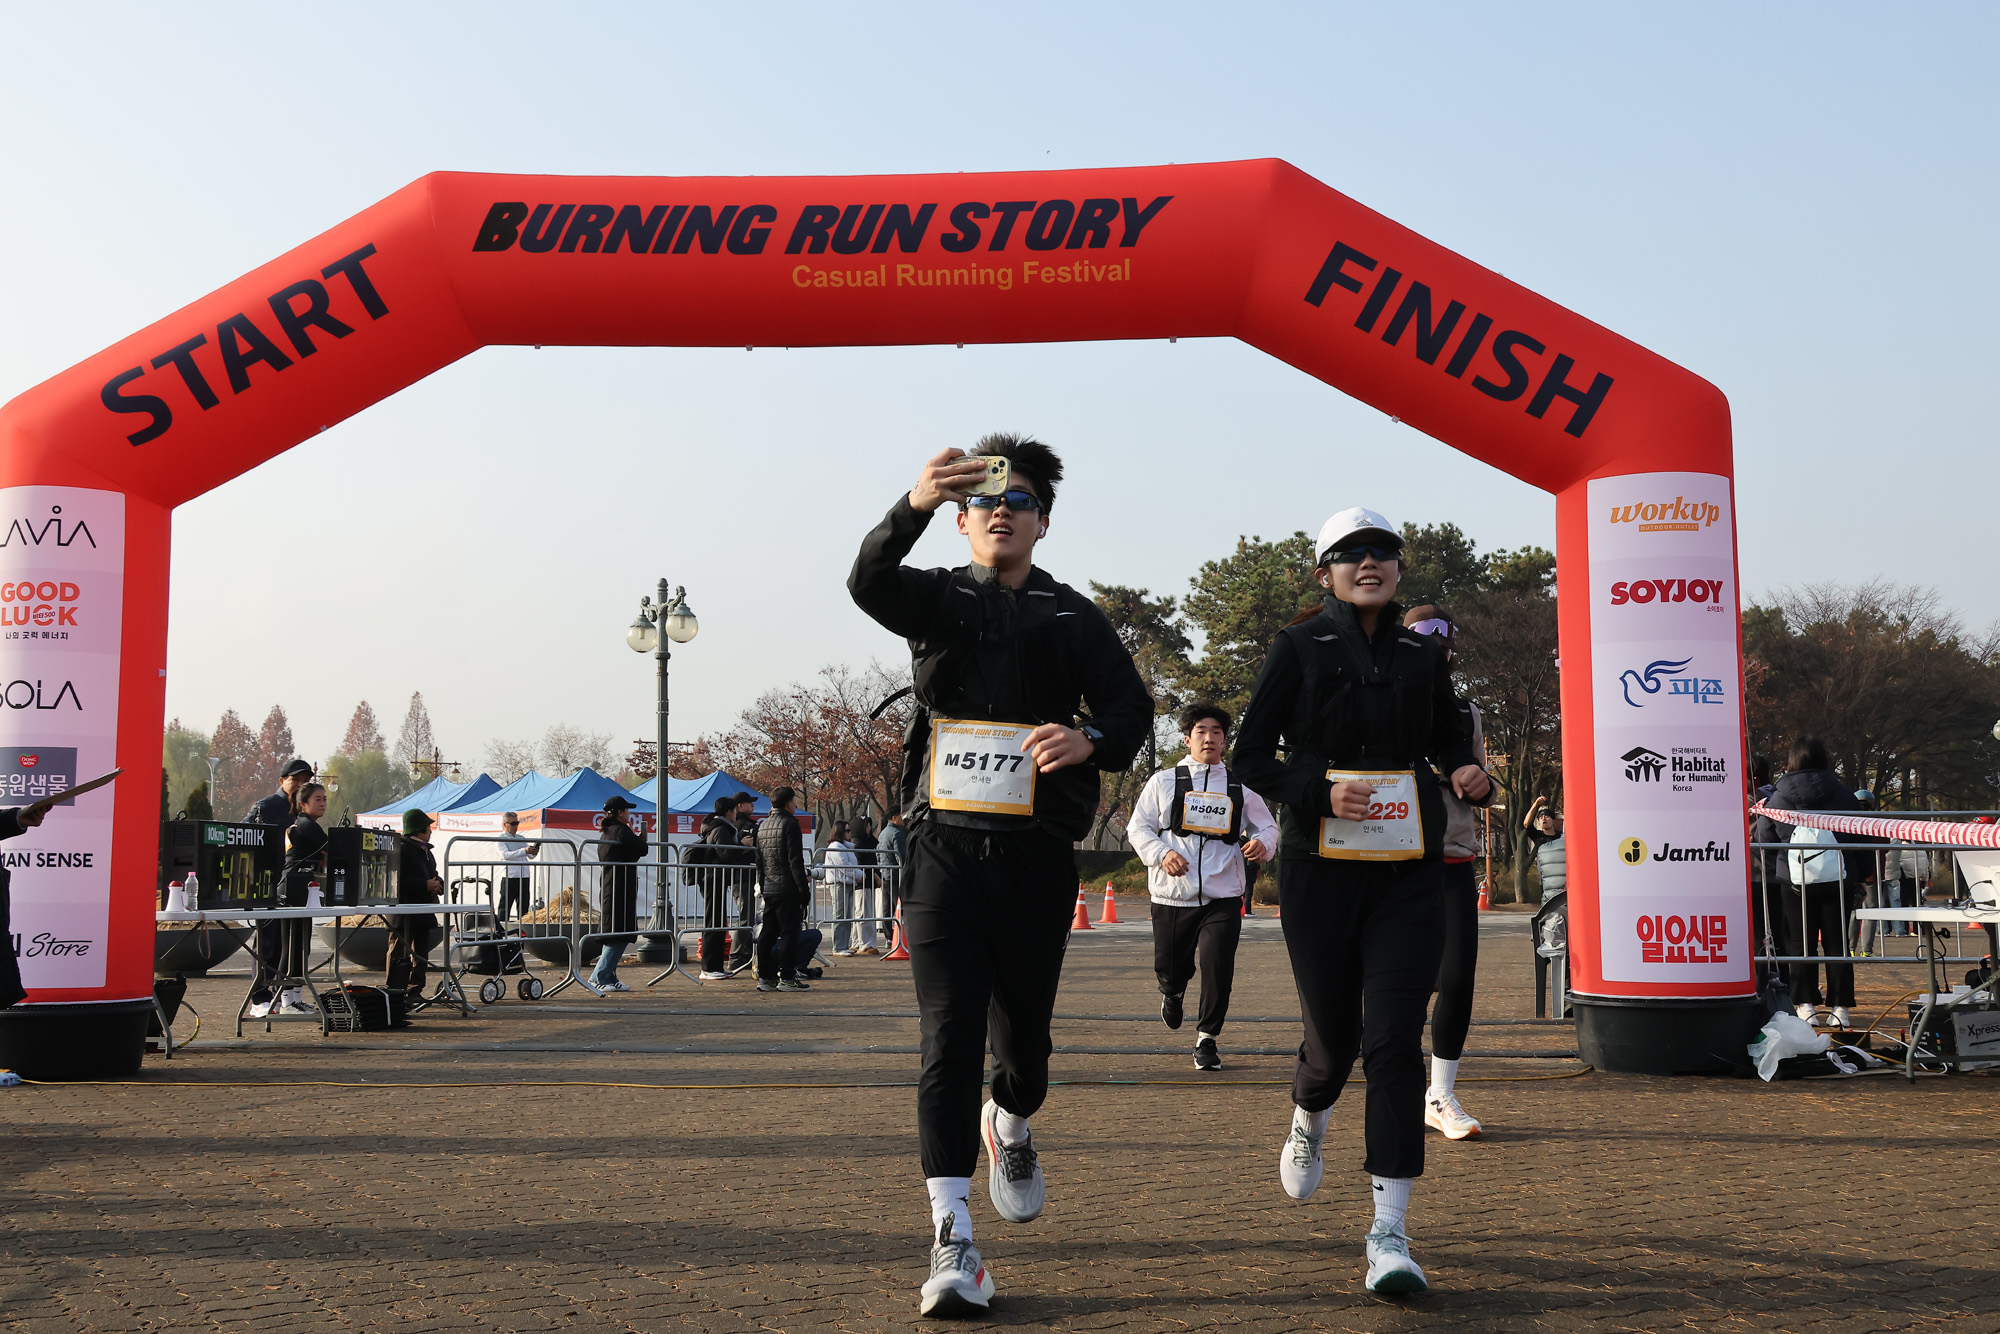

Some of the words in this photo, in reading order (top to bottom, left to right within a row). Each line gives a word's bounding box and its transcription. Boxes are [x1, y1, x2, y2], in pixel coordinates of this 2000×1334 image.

[472, 202, 777, 255] BURNING
[784, 203, 938, 255] RUN
[940, 196, 1175, 252] STORY
[792, 264, 887, 288] Casual
[896, 262, 1013, 290] Running
[1022, 258, 1131, 284] Festival
[101, 242, 390, 447] START
[1303, 240, 1615, 438] FINISH
[1, 581, 80, 602] GOOD
[1610, 579, 1724, 606] SOYJOY
[1, 604, 79, 626] LUCK
[33, 611, 56, 620] 비타500
[5, 631, 20, 639] 나의
[22, 631, 39, 640] 굿럭
[41, 631, 69, 640] 에너지
[1668, 677, 1725, 704] 피죤
[941, 726, 975, 735] BURNING
[975, 728, 992, 736] RUN
[992, 729, 1018, 738] STORY
[944, 752, 1024, 773] M5177
[1671, 756, 1726, 772] Habitat
[1672, 773, 1686, 782] for
[1688, 773, 1726, 784] Humanity
[1672, 784, 1693, 792] Korea
[1190, 804, 1227, 816] M5043
[207, 826, 225, 842] 10km
[227, 827, 265, 847] SAMIK
[1328, 837, 1345, 845] 5km
[36, 852, 94, 868] SENSE
[1653, 840, 1730, 862] Jamful
[26, 932, 93, 957] Store
[1636, 914, 1728, 964] 일요신문
[1966, 1023, 2000, 1040] Xpress
